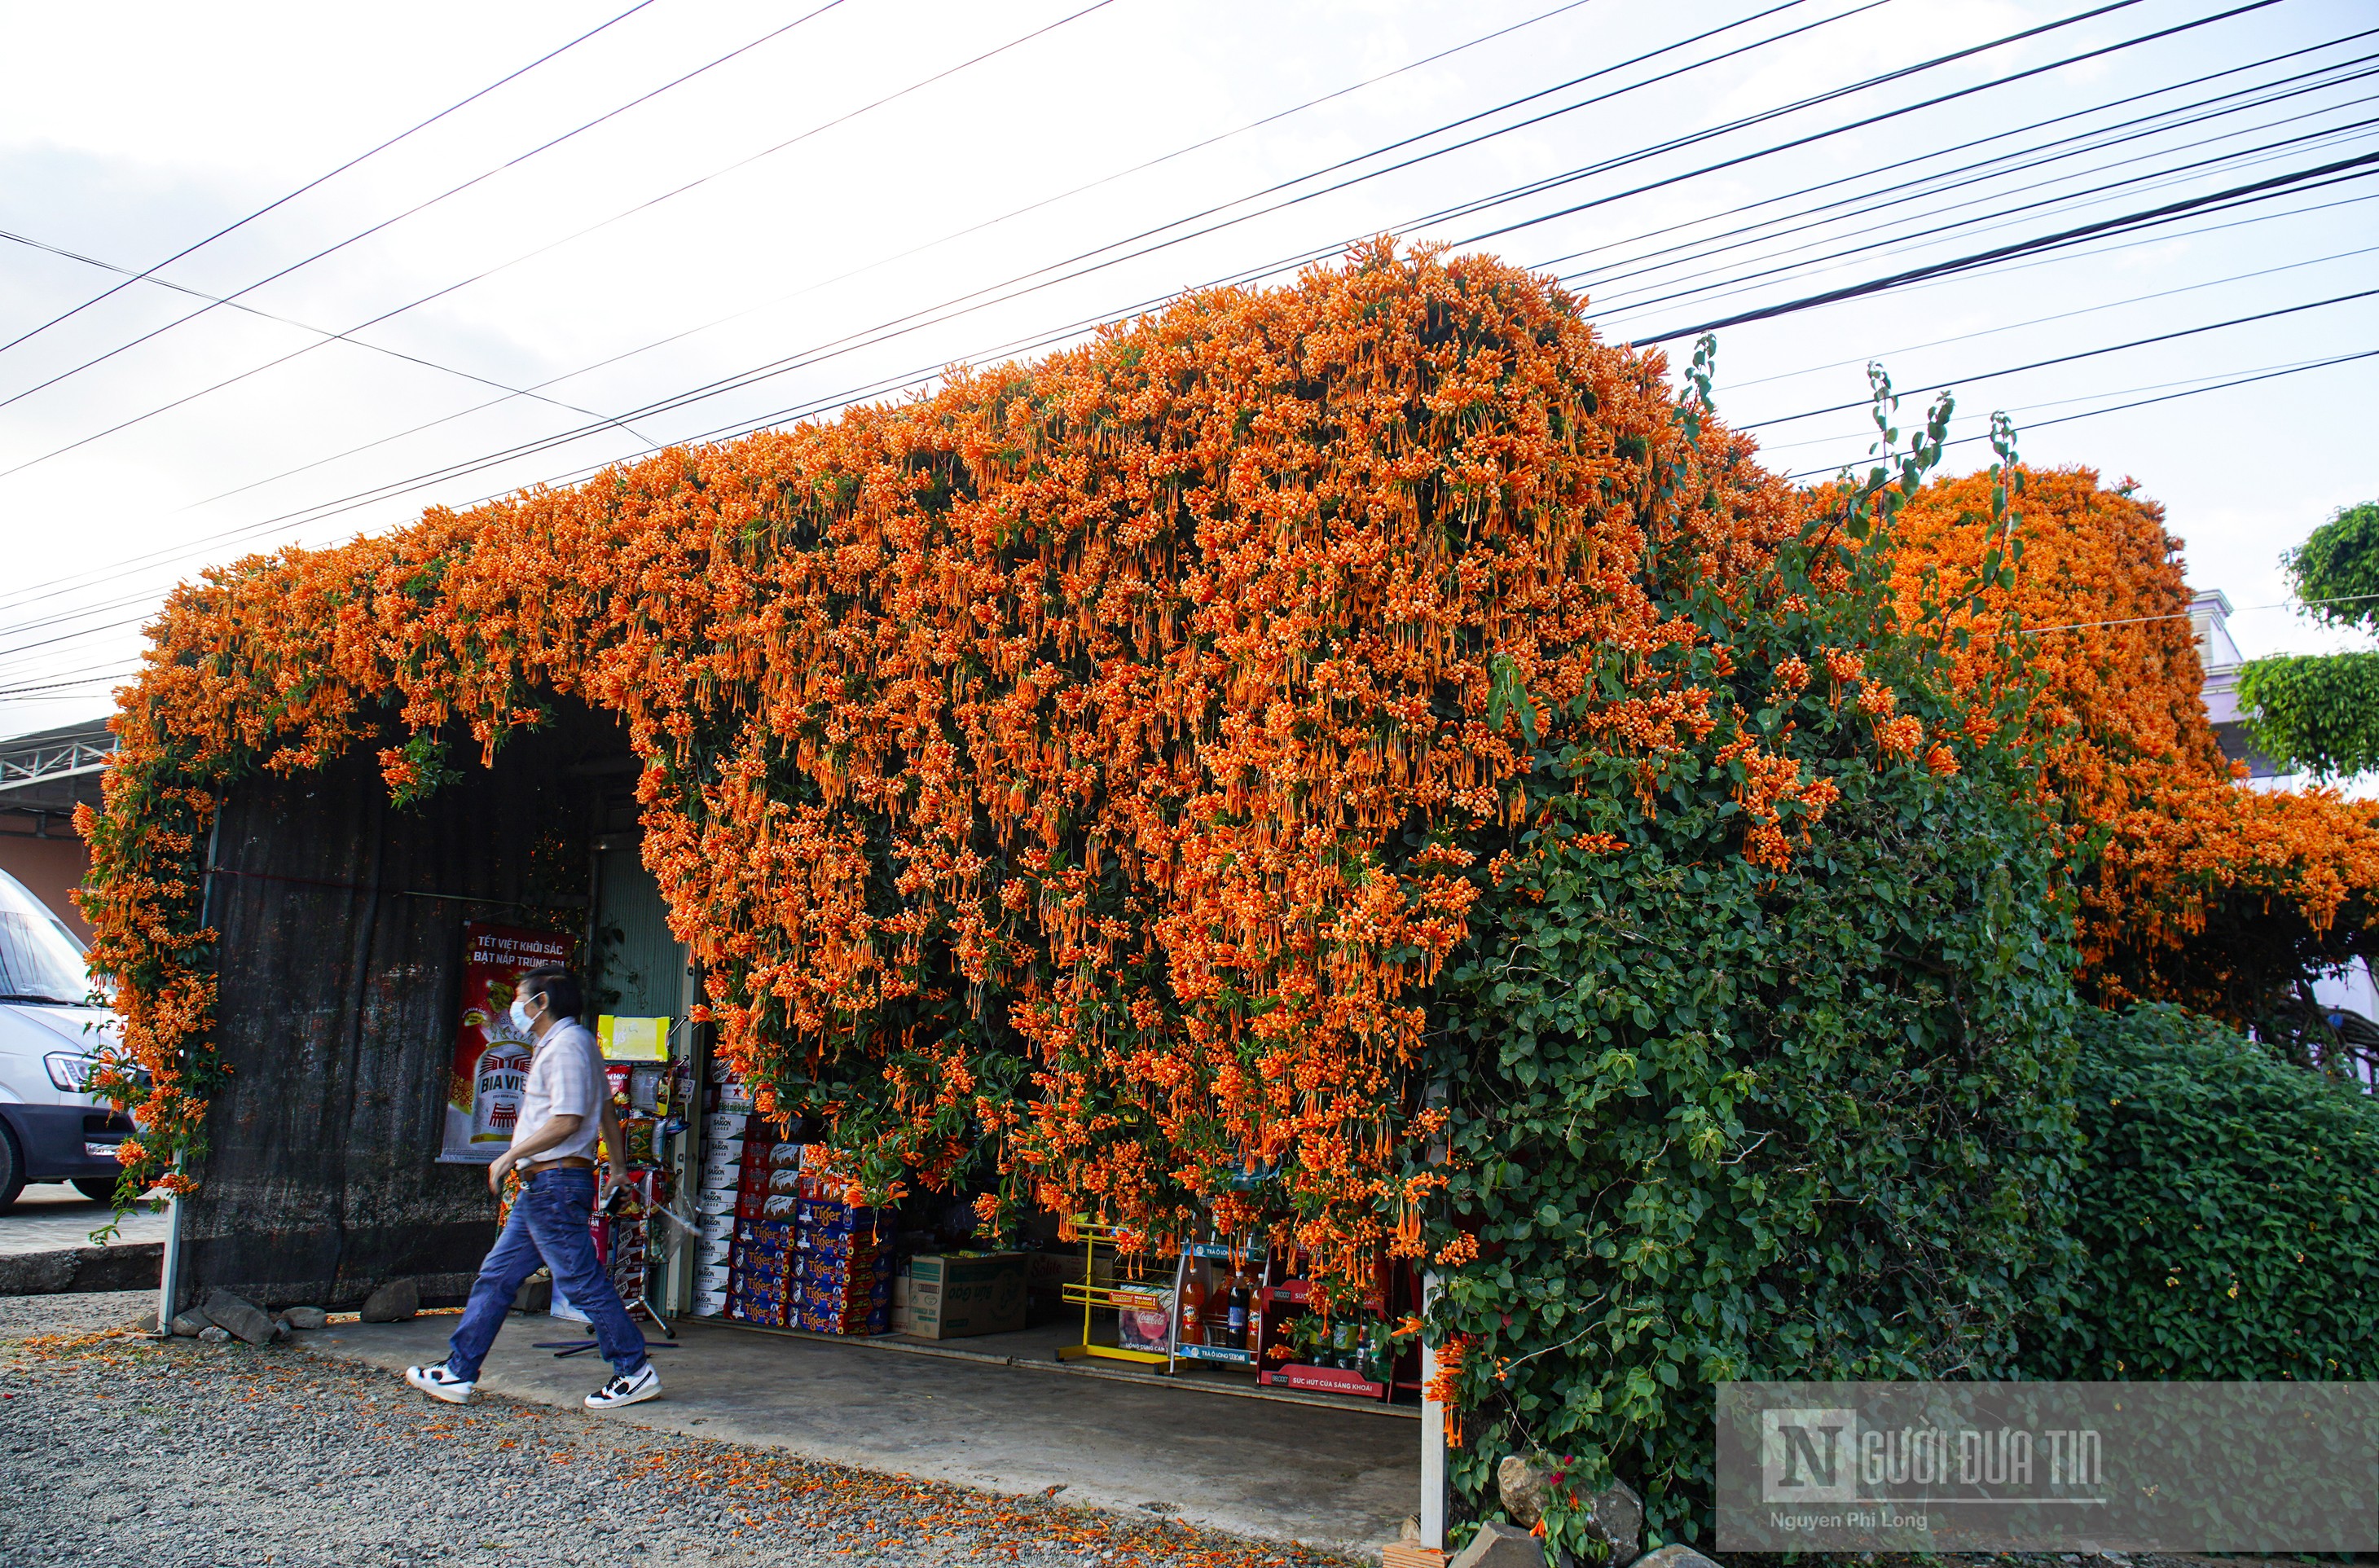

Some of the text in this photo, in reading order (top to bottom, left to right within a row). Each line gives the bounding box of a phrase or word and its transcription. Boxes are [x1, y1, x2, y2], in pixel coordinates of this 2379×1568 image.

[477, 933, 563, 955] TẾT VIỆT KHỞI SẮC
[473, 950, 495, 964] BẬT
[496, 949, 516, 965] NẮP
[481, 1074, 527, 1095] BIA VIỆ
[718, 1102, 750, 1113] Heineken
[812, 1205, 842, 1227] Tiger
[754, 1224, 778, 1244] Tiger
[811, 1232, 837, 1252] Tiger
[748, 1250, 772, 1270] Tiger
[808, 1258, 834, 1279] Tiger
[747, 1276, 771, 1296] Tiger
[806, 1285, 830, 1305] Tiger
[745, 1302, 769, 1322] Tiger
[803, 1311, 827, 1332] Tiger
